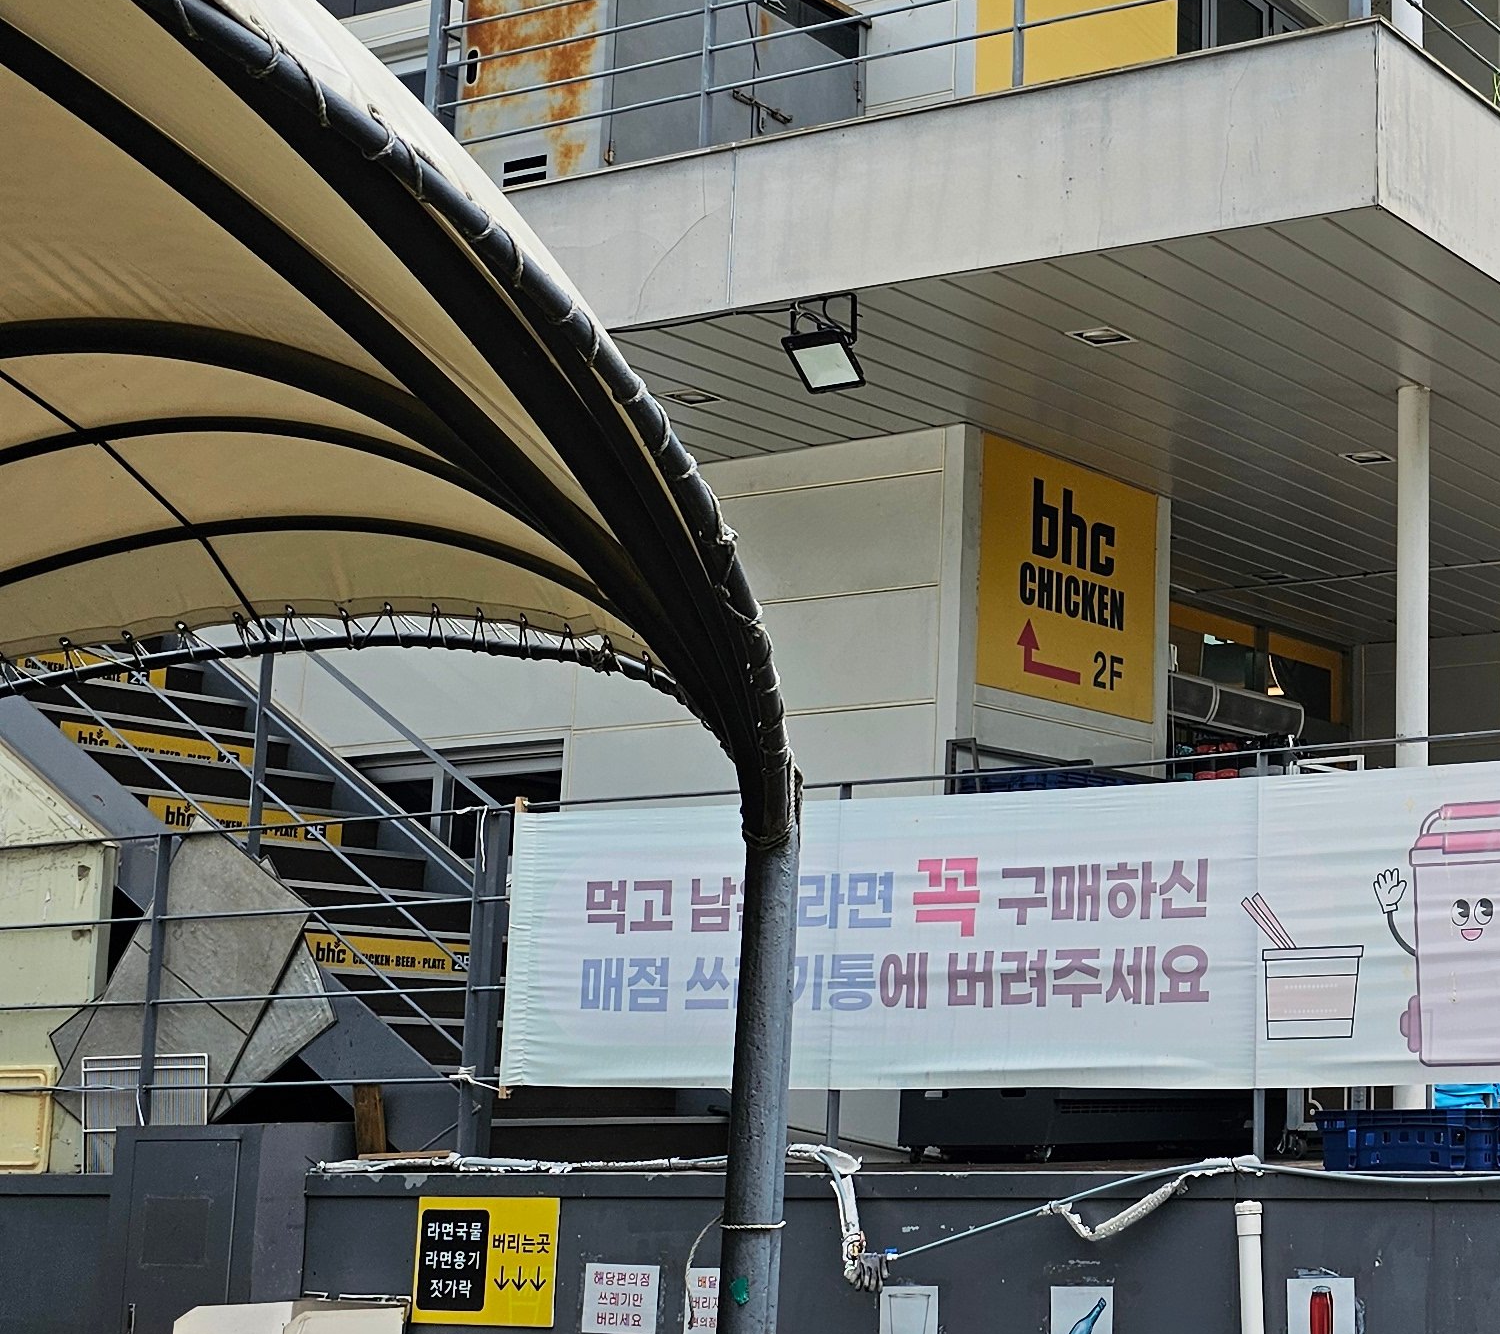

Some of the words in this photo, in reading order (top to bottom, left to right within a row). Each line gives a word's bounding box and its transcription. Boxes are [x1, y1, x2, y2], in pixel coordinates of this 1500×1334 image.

[1032, 477, 1116, 577] bhc
[1020, 562, 1125, 631] CHICKEN
[1093, 651, 1124, 691] 2F
[586, 878, 673, 935] 먹고
[690, 876, 744, 933] 남
[797, 871, 895, 930] 라면
[912, 857, 981, 937] 꼭
[998, 857, 1209, 927] 구매하신
[316, 940, 347, 965] bhc
[353, 953, 391, 968] CHICKEN
[395, 955, 416, 969] BEER
[422, 957, 446, 971] PLATE
[580, 956, 671, 1014] 매점
[684, 952, 928, 1012] 쓰기통에
[947, 943, 1211, 1009] 버려주세요
[427, 1221, 483, 1241] 라면국물
[492, 1233, 551, 1255] 버리는곳
[425, 1250, 481, 1270] 라면용기
[429, 1279, 472, 1299] 젓가락
[593, 1270, 651, 1288] 해당편의점
[697, 1275, 717, 1290] 배달
[597, 1291, 644, 1309] 쓰레기만
[596, 1311, 642, 1328] 버리세요
